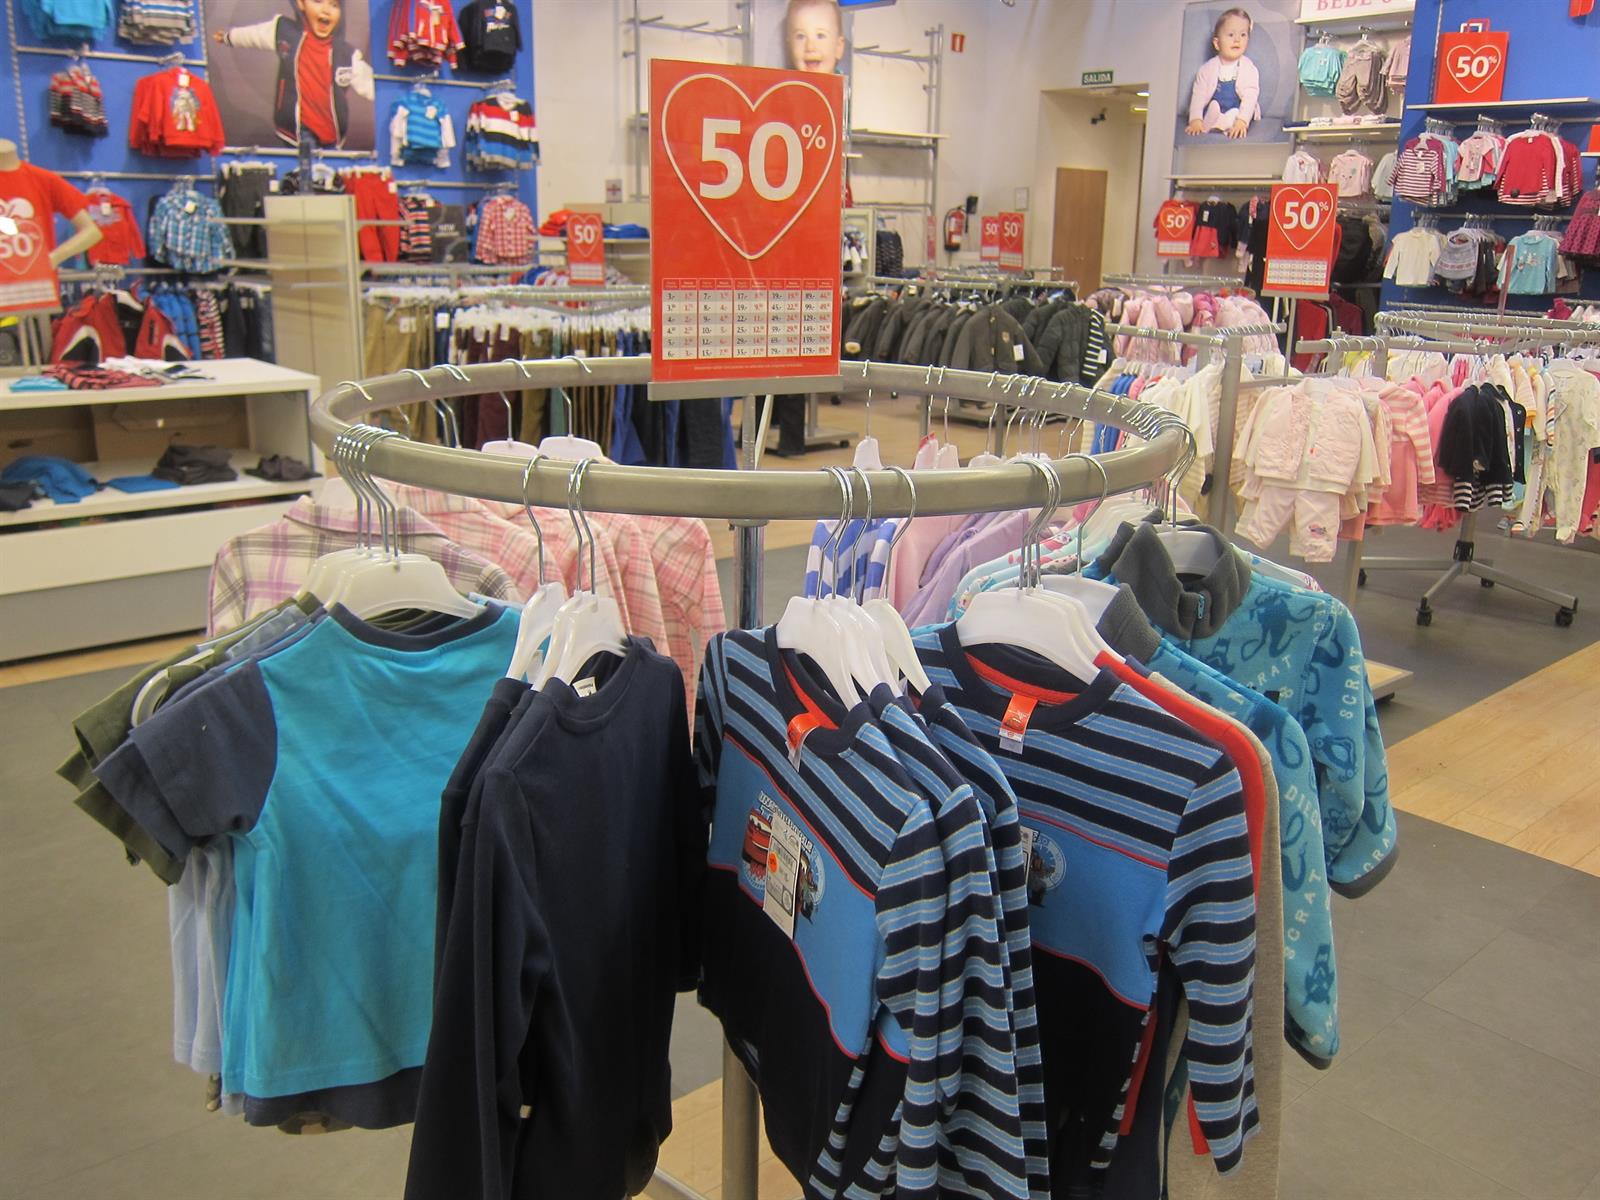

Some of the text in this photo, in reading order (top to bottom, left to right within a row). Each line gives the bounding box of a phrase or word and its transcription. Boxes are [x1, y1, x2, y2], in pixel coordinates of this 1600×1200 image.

[1083, 72, 1111, 84] SALIDA
[1455, 55, 1498, 78] 50%
[700, 117, 827, 202] 50%
[1282, 201, 1329, 230] 50%
[1339, 646, 1362, 719] SCRAT
